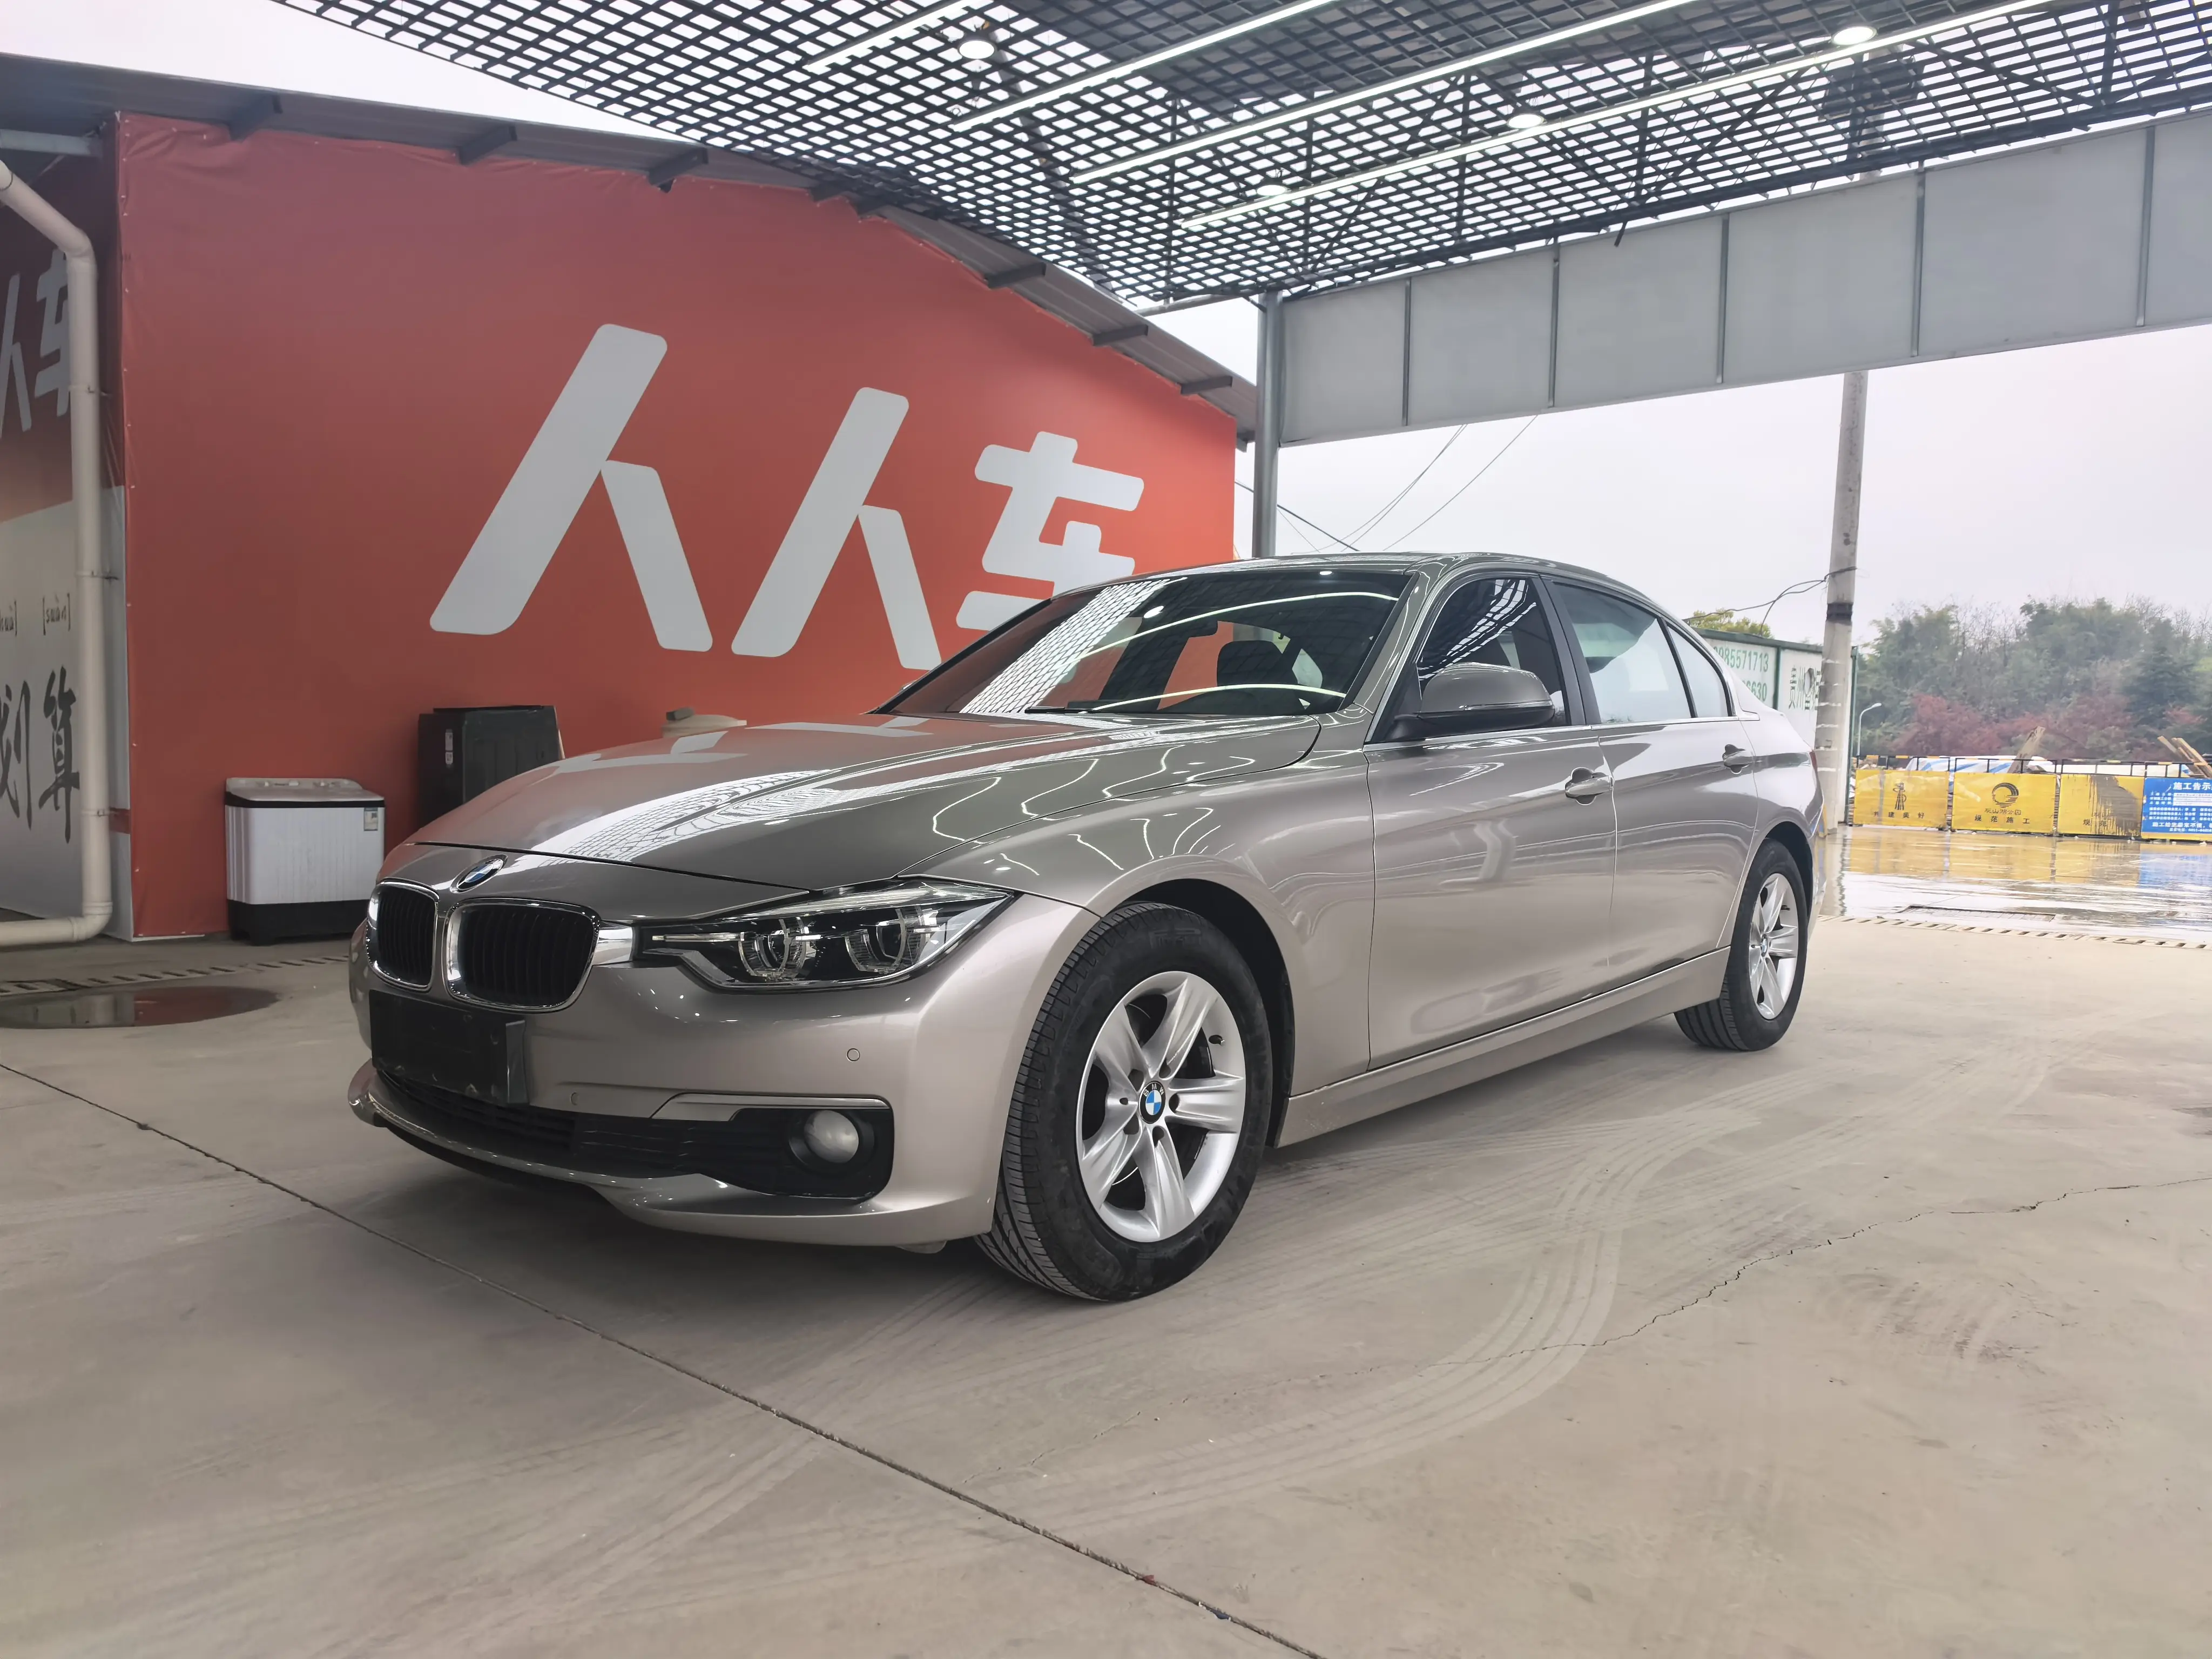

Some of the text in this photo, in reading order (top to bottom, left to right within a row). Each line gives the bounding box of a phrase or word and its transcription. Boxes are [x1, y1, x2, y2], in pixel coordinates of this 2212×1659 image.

[429, 323, 1145, 672] 人人车
[2173, 781, 2212, 791] 施工告示
[1974, 814, 2030, 824] 规范施工
[1143, 1083, 1164, 1097] BMW
